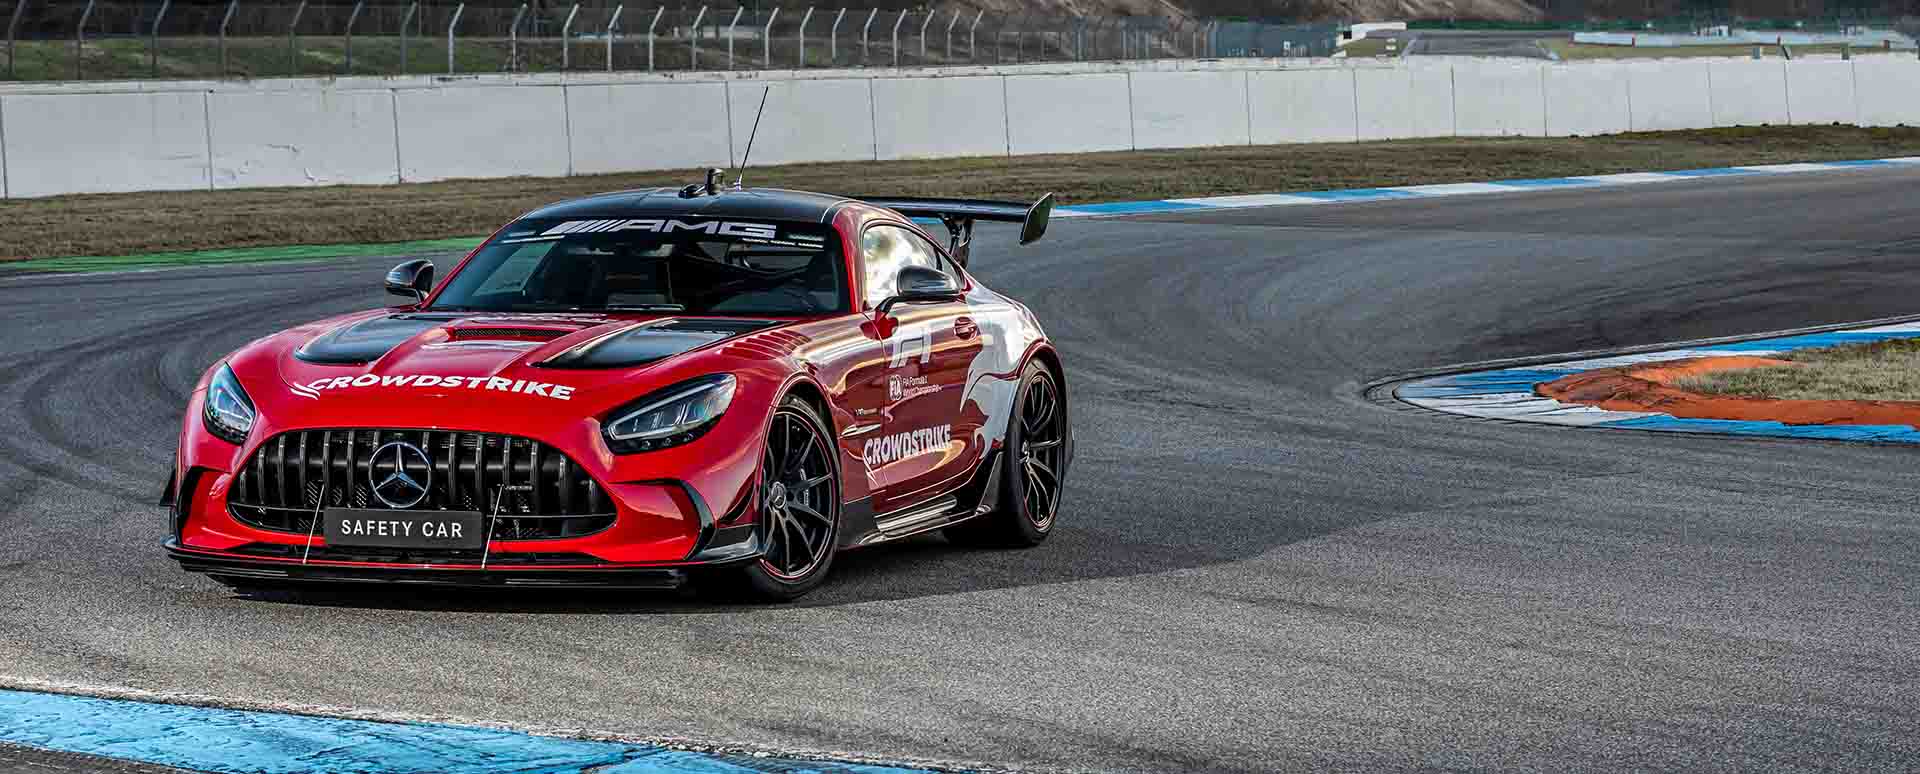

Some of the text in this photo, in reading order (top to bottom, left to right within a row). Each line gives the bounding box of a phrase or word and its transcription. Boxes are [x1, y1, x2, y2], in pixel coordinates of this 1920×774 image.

[608, 219, 777, 238] AMG
[306, 374, 577, 401] CROWDSTRIKE
[889, 374, 902, 400] FIA
[864, 424, 952, 464] CROWDSTRIKE
[341, 519, 463, 538] SAFETY CAR
